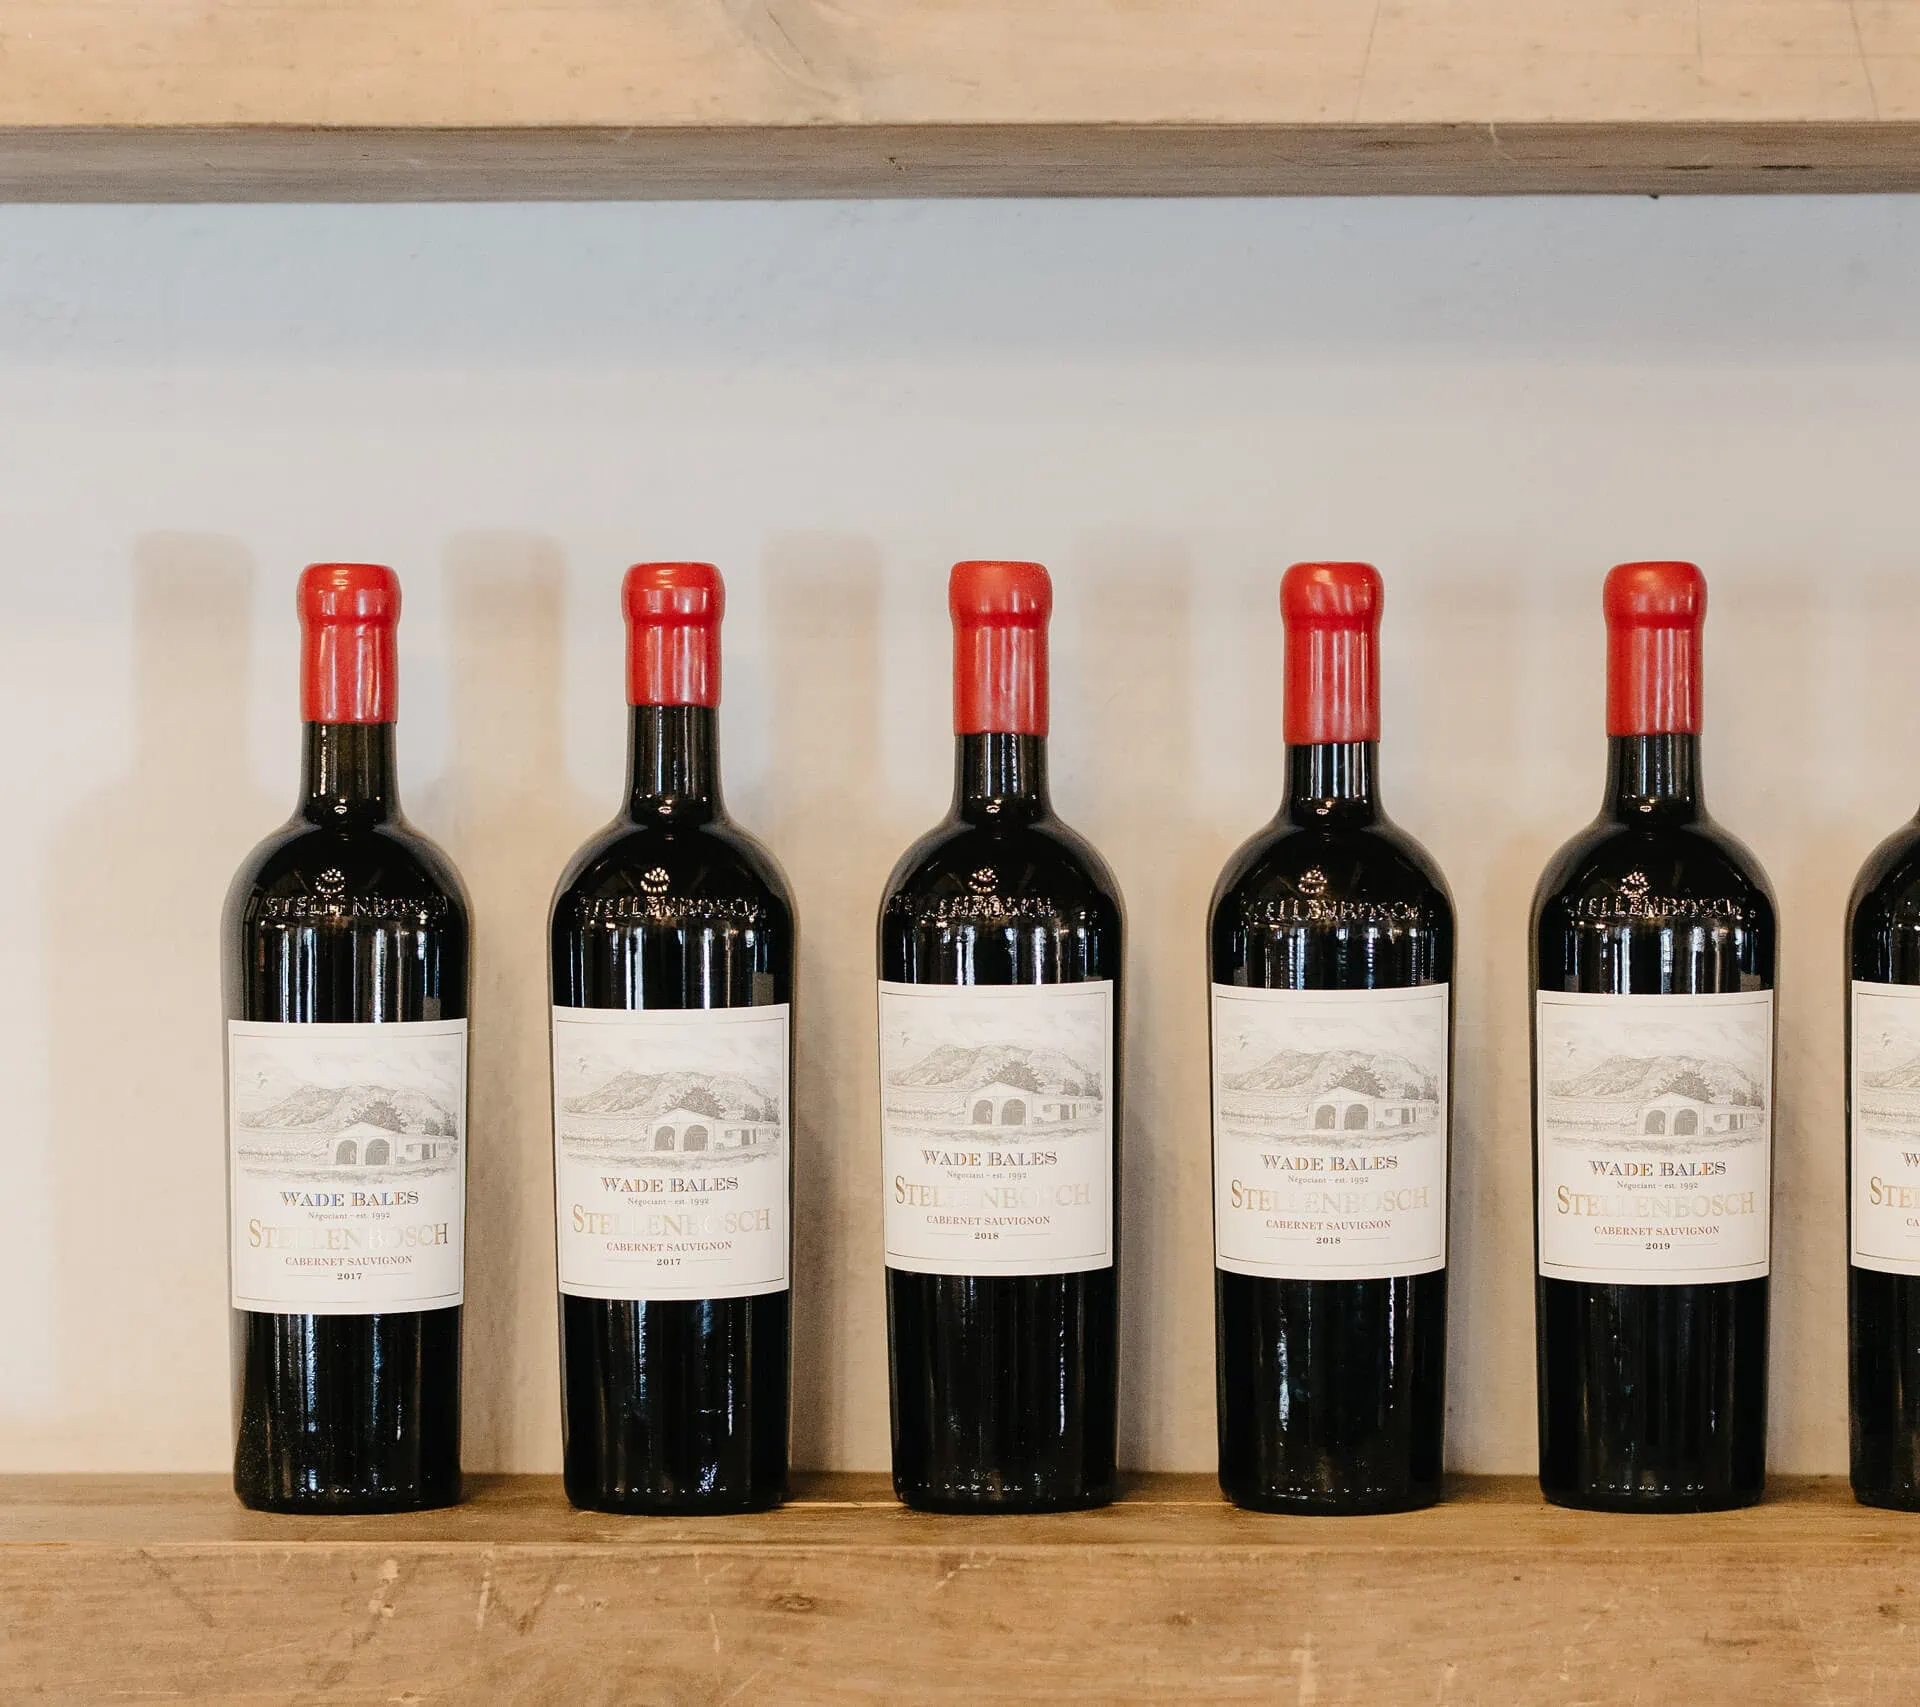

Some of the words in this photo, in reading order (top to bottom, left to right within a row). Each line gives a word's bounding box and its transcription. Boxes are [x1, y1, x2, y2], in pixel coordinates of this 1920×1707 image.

[921, 1149, 981, 1167] WADE
[988, 1150, 1058, 1167] BALES
[1262, 1154, 1324, 1171] WADE
[1329, 1154, 1399, 1171] BALES
[1589, 1160, 1653, 1177] WADE
[1659, 1160, 1726, 1177] BALES
[1008, 1172, 1027, 1180] 1992
[1351, 1176, 1369, 1185] 1992
[600, 1176, 663, 1193] WADE
[669, 1176, 739, 1193] BALES
[1680, 1182, 1699, 1190] 1992
[280, 1191, 345, 1207] WADE
[351, 1191, 419, 1207] BALES
[690, 1198, 709, 1206] 1992
[1557, 1185, 1754, 1218] STELLENBOSCH
[372, 1212, 390, 1220] 1992
[926, 1215, 982, 1226] CABERNET
[984, 1215, 1050, 1226] SAUVIGNON
[1266, 1219, 1323, 1230] CABERNET
[1326, 1219, 1391, 1230] SAUVIGNON
[974, 1232, 1000, 1240] 2018
[1594, 1226, 1652, 1236] CABERNET
[1656, 1225, 1720, 1236] SAUVIGNON
[606, 1242, 663, 1251] CABERNET
[666, 1240, 732, 1251] SAUVIGNON
[1316, 1237, 1341, 1245] 2018
[1645, 1242, 1671, 1250] 2019
[285, 1257, 345, 1266] CABERNET
[347, 1255, 413, 1266] SAUVIGNON
[656, 1258, 681, 1266] 2017
[336, 1272, 363, 1280] 2017
